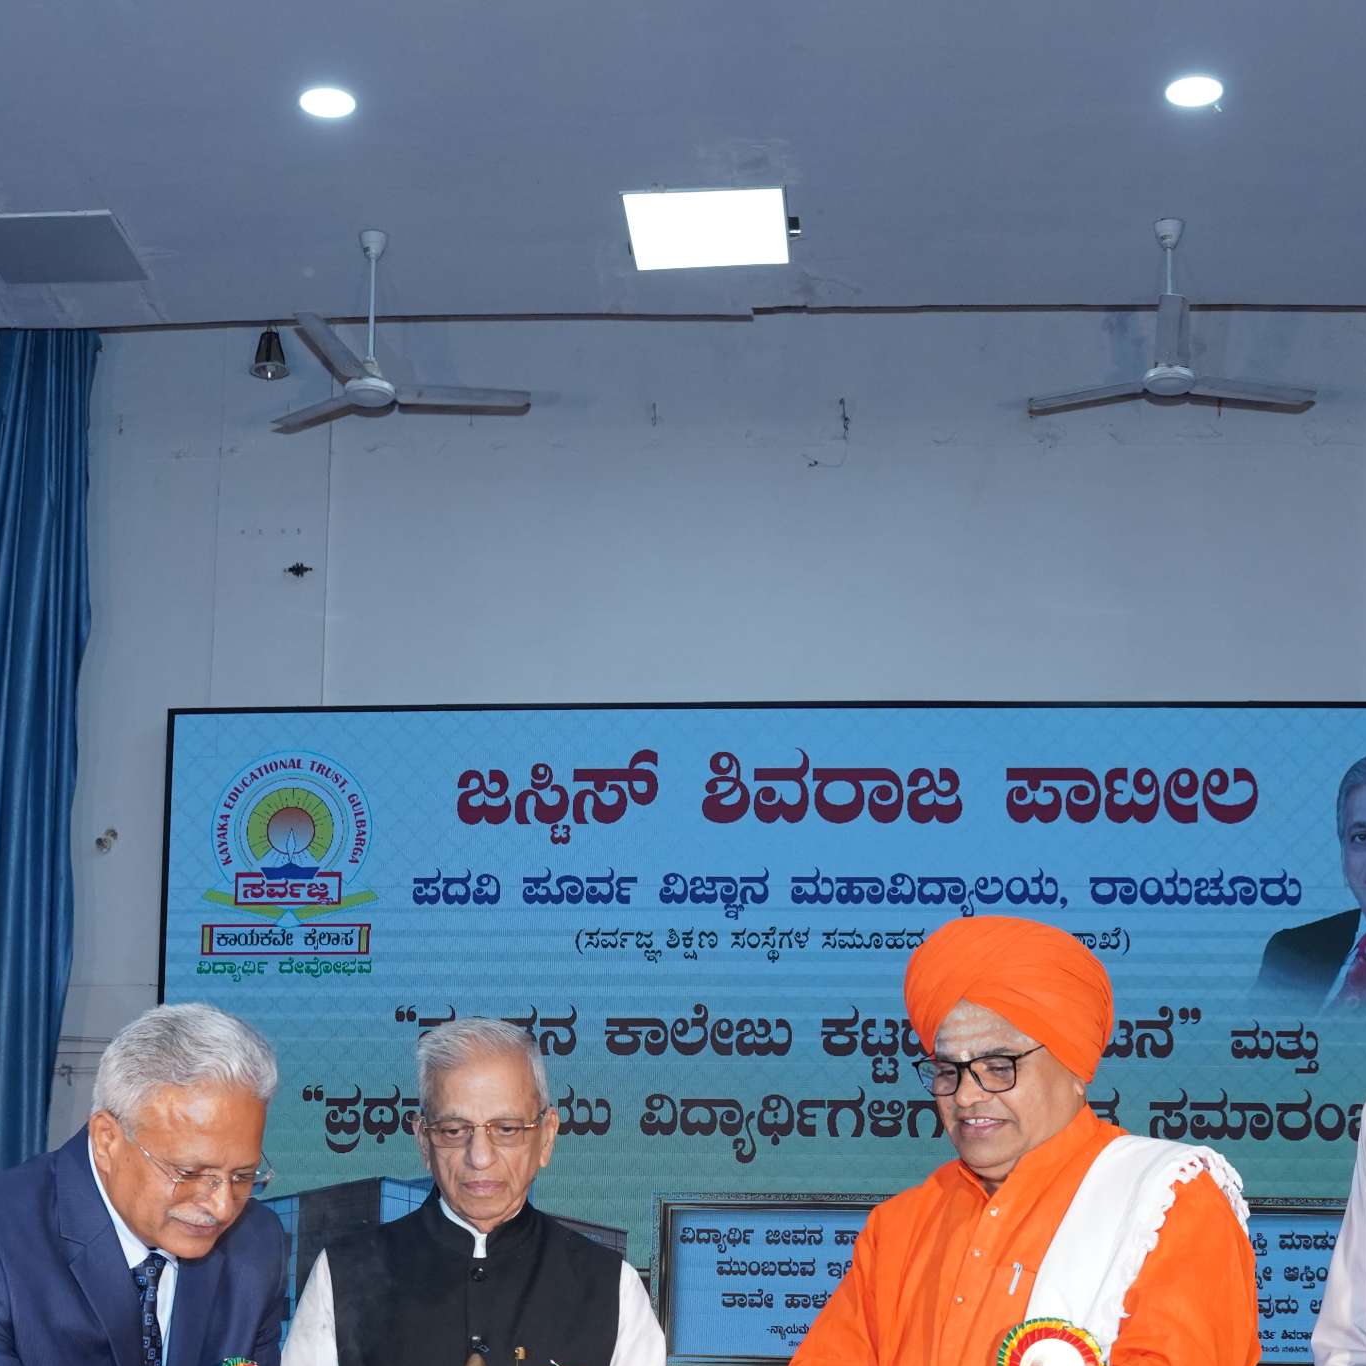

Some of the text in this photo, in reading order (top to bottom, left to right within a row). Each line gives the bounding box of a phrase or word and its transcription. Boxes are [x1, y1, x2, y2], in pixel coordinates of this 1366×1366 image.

[456, 747, 1259, 845] ಜಸ್ಟಿಸ್ ಶಿವರಾಜ ಪಾಟೀಲ
[216, 757, 367, 867] KAYAKA EDUCATIONAL TRUST, GULBARGA
[242, 879, 335, 906] ಸರ್ವಜ್ಞ
[412, 866, 1303, 920] ಪದವಿ ಪೂರ್ವ ವಿಜ್ಞಾನ ಮಹಾವಿದ್ಯಾಲಯ, ರಾಯಚೂರು
[216, 927, 355, 951] ಕಾಯಕವೇ ಕೈಲಾಸ
[575, 928, 662, 964] (ಸರ್ವಜ್ಞ
[666, 928, 718, 960] ಶಿಕ್ಷಣ
[730, 926, 811, 963] ಸಂಸ್ಥೆಗಳ
[196, 958, 269, 983] ವಿದ್ಯಾರ್ಥಿ
[604, 1003, 793, 1056] ಕಾಲೇಜು
[1230, 1019, 1320, 1075] ಮತ್ತು
[679, 1226, 755, 1254] ವಿದ್ಯಾರ್ಥಿ
[765, 1225, 824, 1246] ಜೀವನ
[716, 1256, 817, 1278] ಮುಂಬರುವ
[721, 1288, 775, 1309] ತಾವೇ
